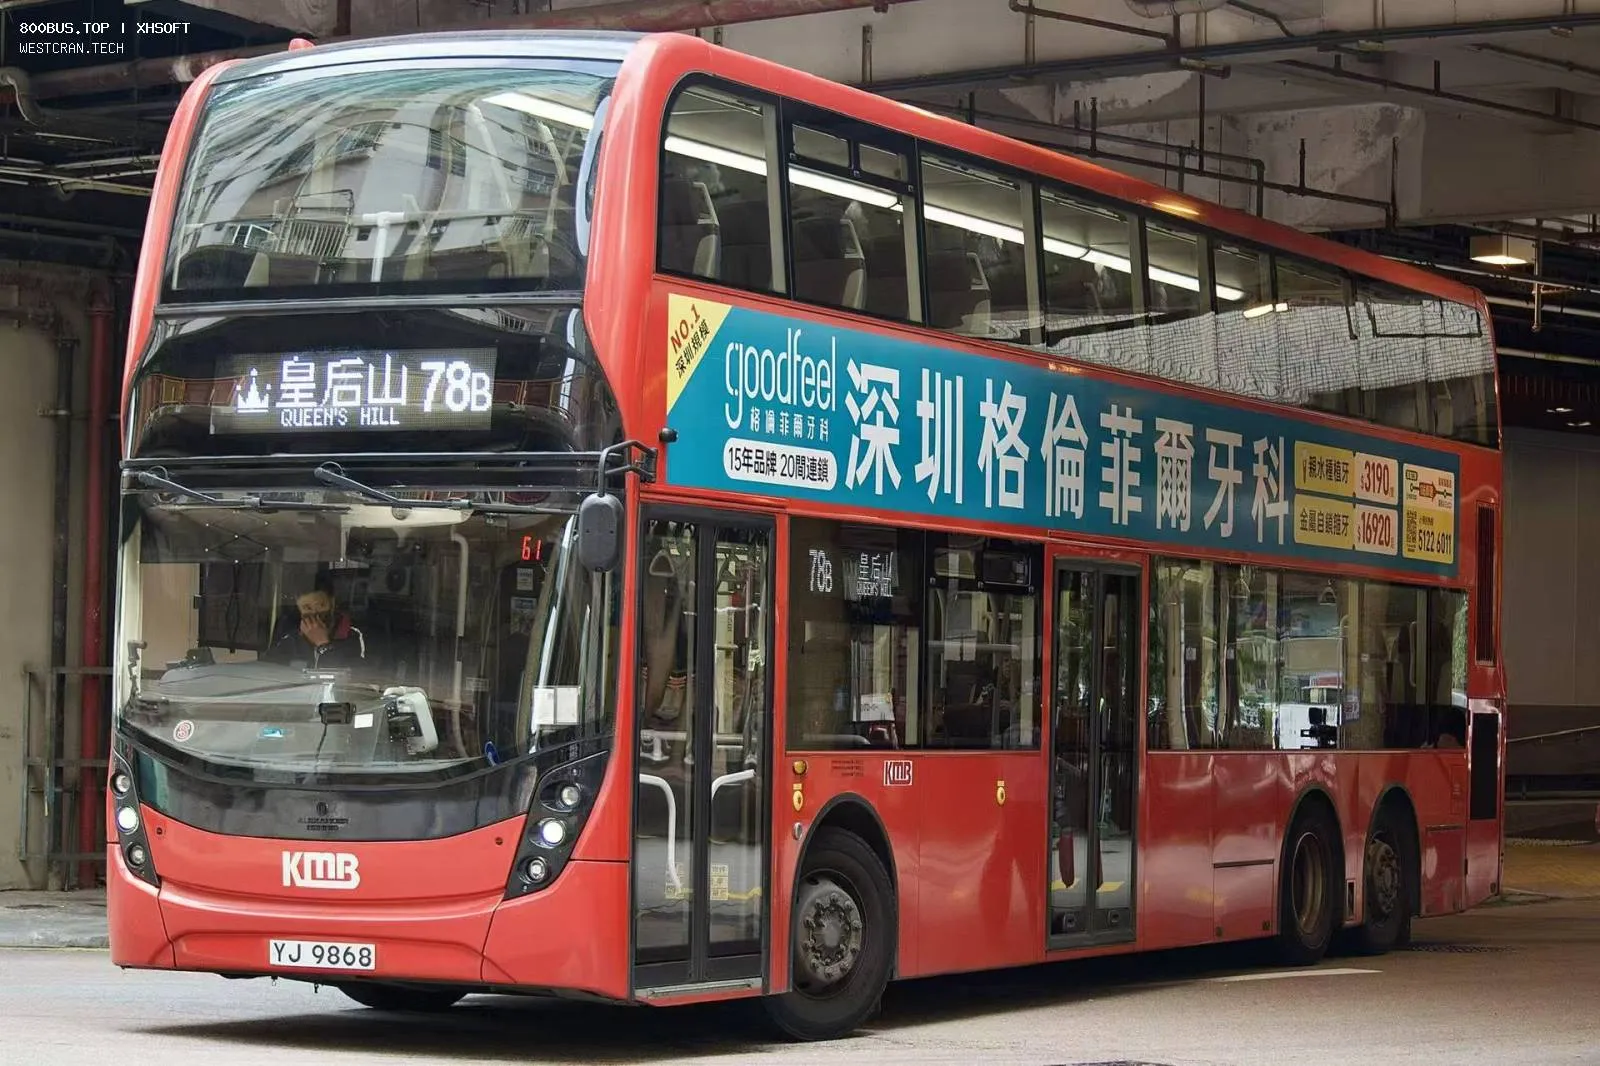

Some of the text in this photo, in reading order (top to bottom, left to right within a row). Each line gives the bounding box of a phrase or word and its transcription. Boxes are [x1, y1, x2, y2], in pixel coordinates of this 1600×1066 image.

[670, 304, 700, 354] NO.1
[675, 318, 710, 379] 深圳規模
[275, 353, 493, 412] 皇后山 78B
[725, 327, 836, 430] goodfeel
[280, 406, 400, 427] QUEEN'S HILL
[750, 406, 829, 443] 格倫菲爾牙科
[729, 446, 829, 483] 15年品牌 20間連鎖
[845, 358, 1289, 545] 深圳格倫菲爾牙科
[521, 535, 542, 560] 61
[809, 549, 832, 592] 78B
[884, 760, 913, 786] KMB
[282, 850, 361, 890] KMB
[273, 942, 372, 968] YJ 9868
